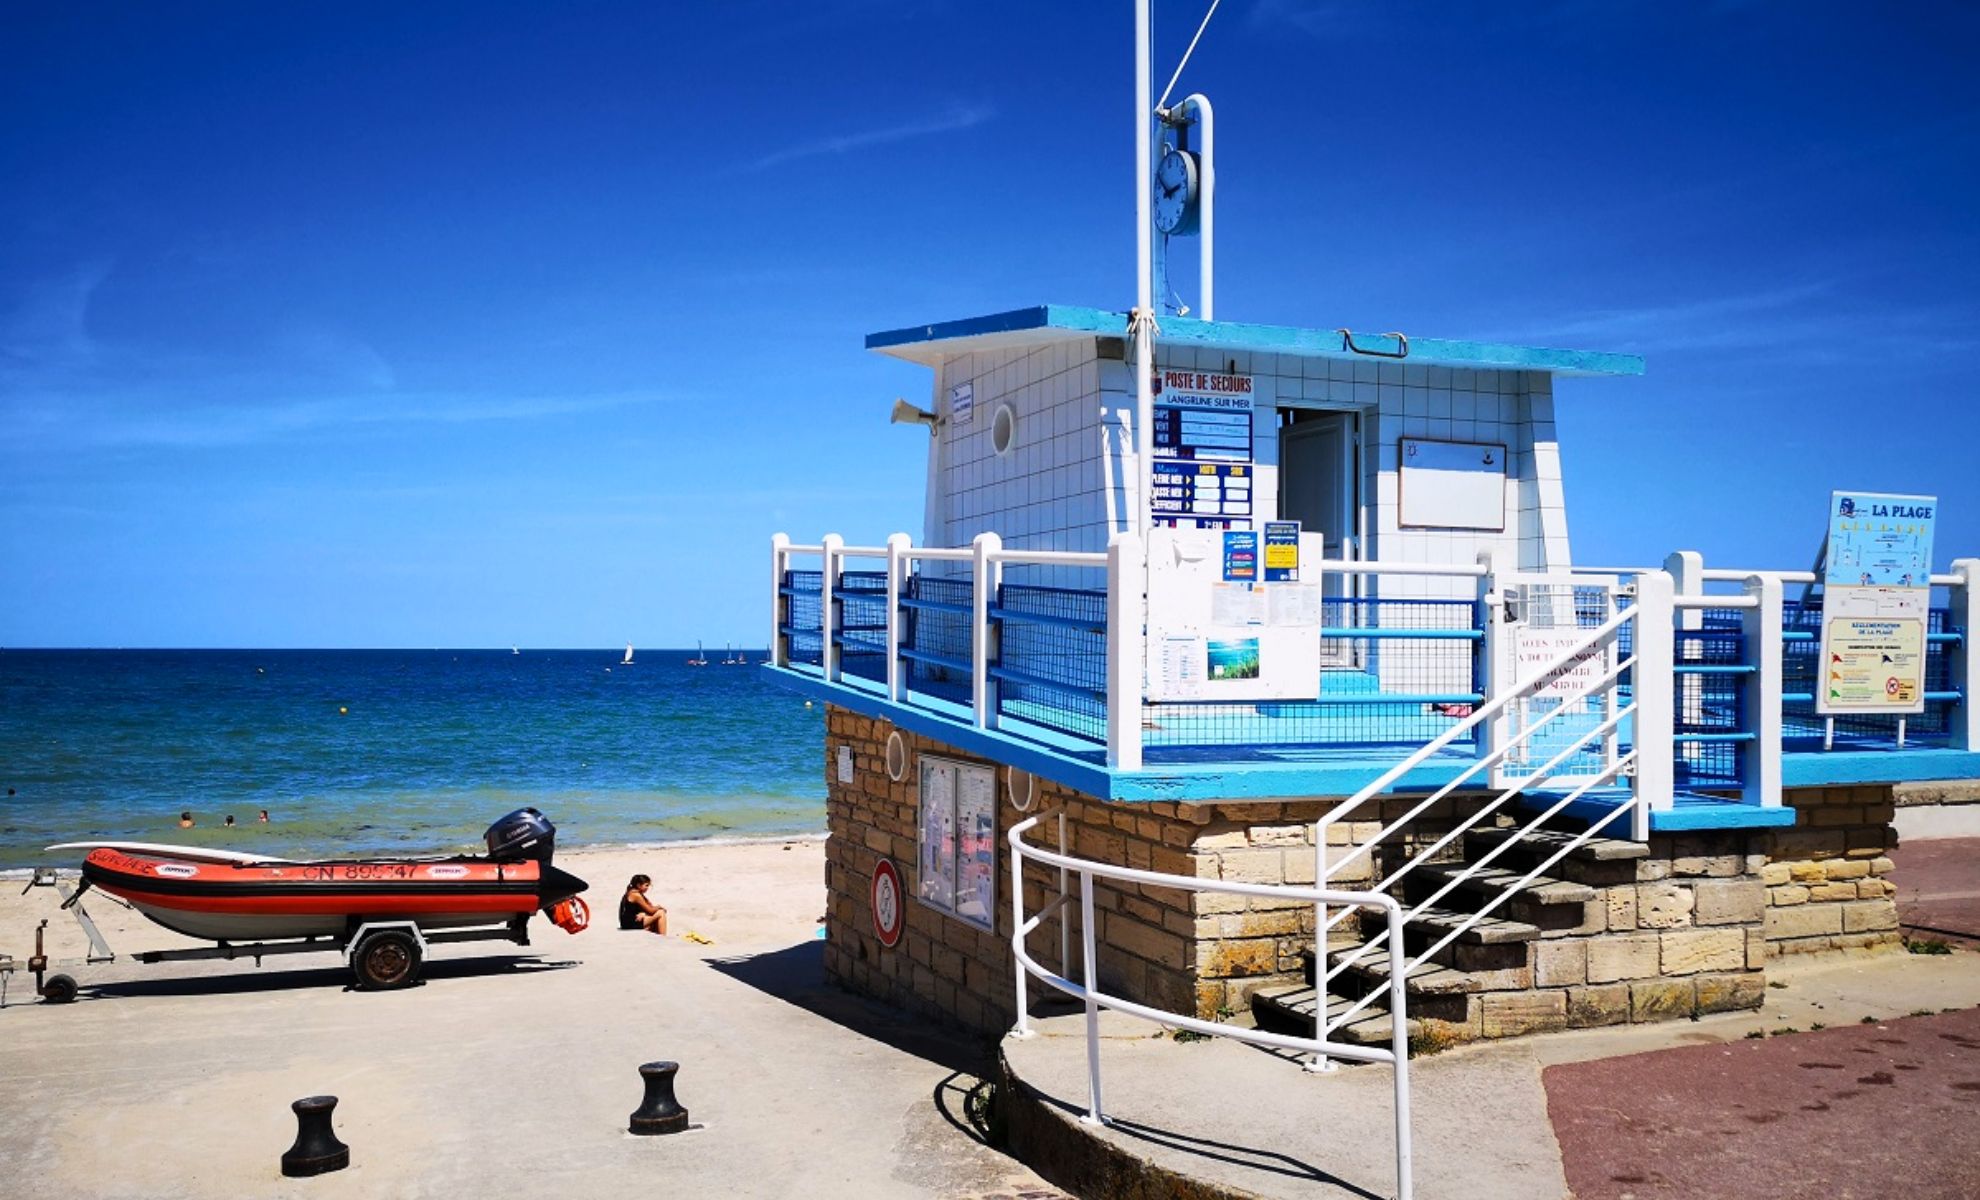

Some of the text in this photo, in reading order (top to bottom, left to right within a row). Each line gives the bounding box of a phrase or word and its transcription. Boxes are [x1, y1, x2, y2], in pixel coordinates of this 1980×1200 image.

[1165, 371, 1252, 393] POSTE DE SECOURS
[1166, 395, 1250, 409] LANGRUNE SUR MER
[1153, 409, 1169, 420] EMPS
[1872, 504, 1933, 519] LA PLAGE
[303, 866, 334, 881] CN
